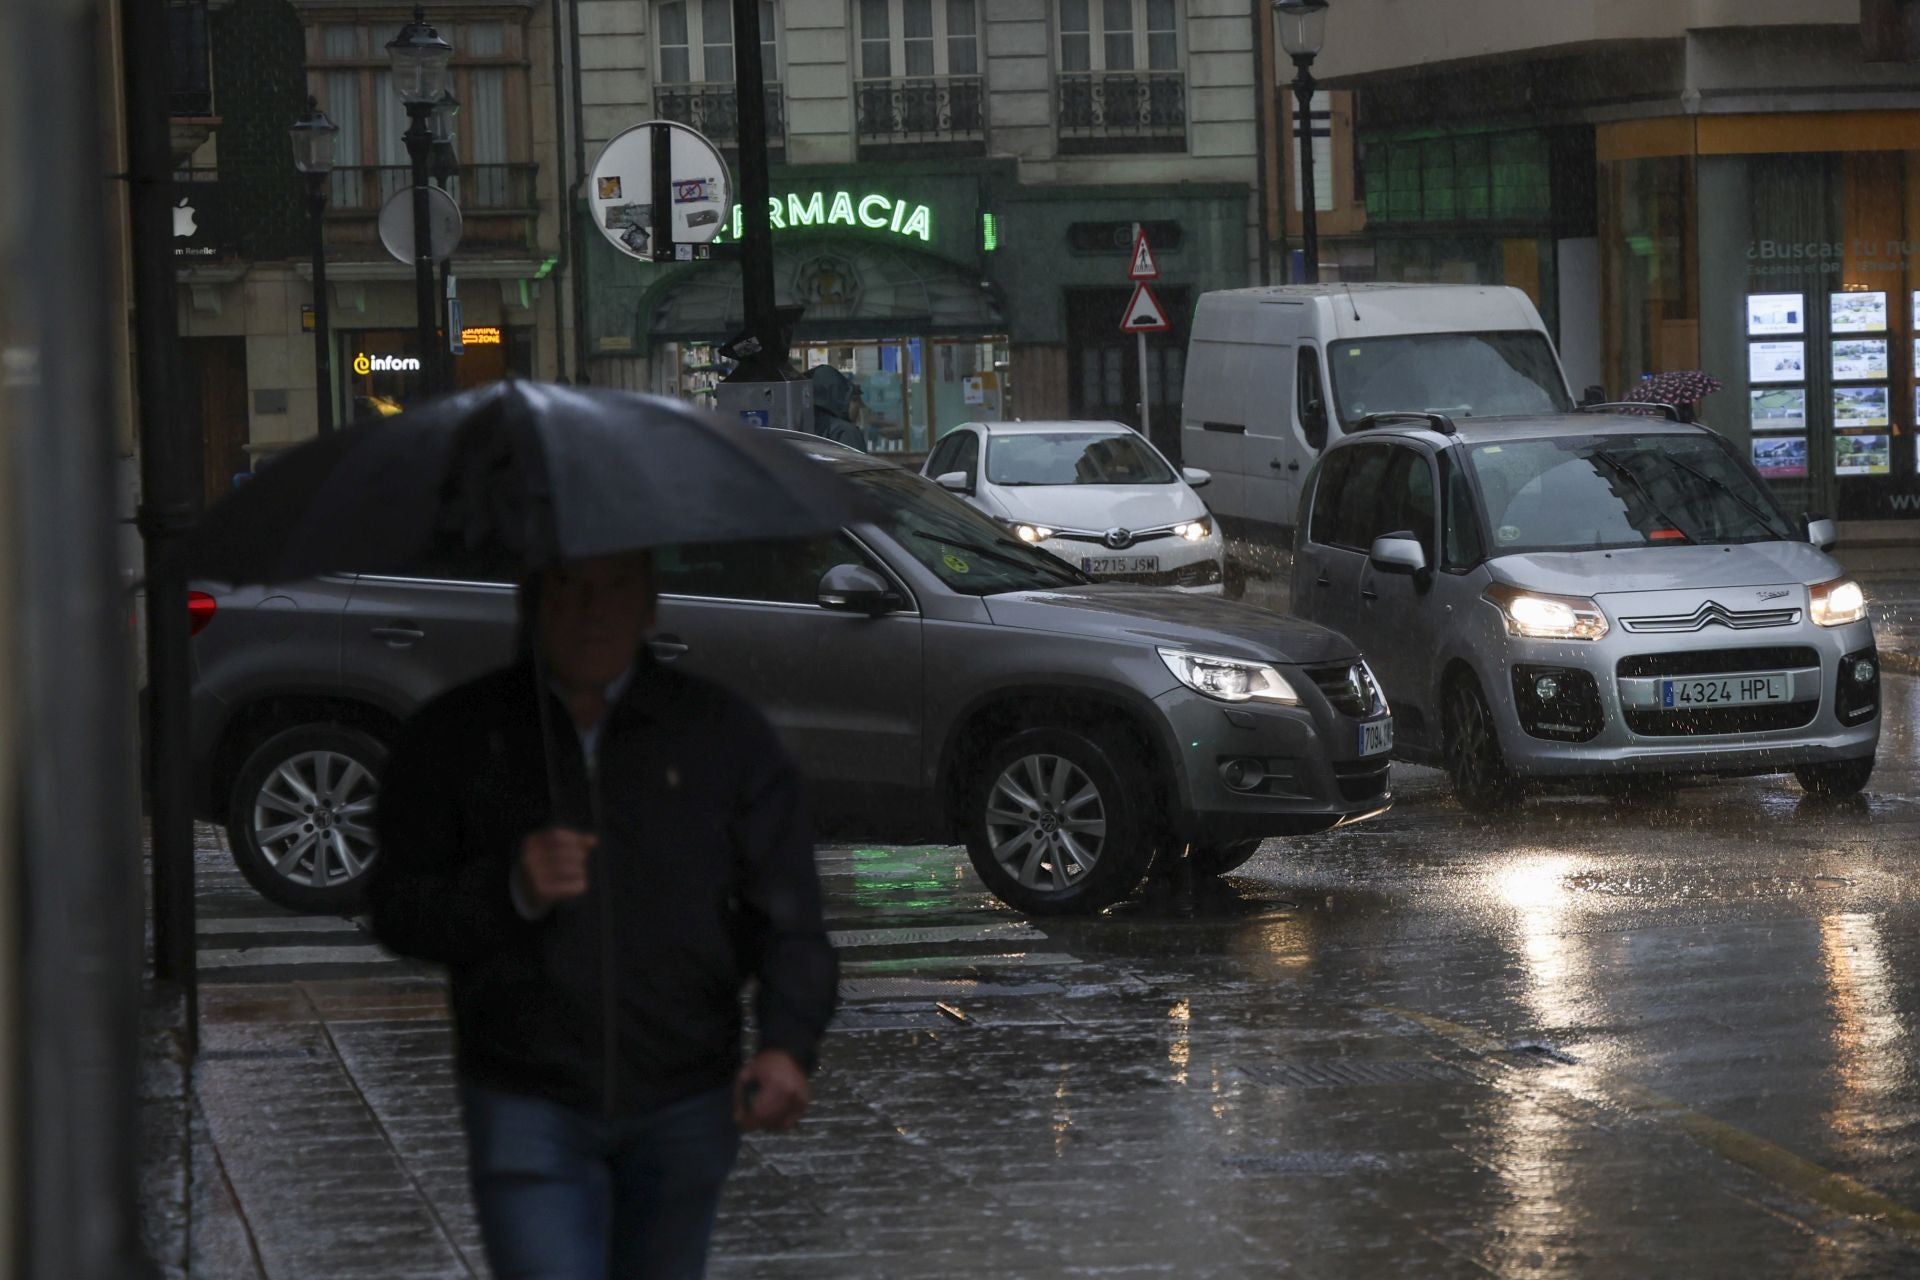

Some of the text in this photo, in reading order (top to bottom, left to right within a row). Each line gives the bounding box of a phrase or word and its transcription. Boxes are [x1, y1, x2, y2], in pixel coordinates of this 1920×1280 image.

[712, 191, 930, 242] RMACIA
[1747, 240, 1845, 259] ¿Buscas
[1853, 239, 1877, 257] tu
[478, 335, 500, 344] ZONE
[1093, 559, 1126, 572] 2715
[1680, 681, 1732, 703] 4324
[1741, 678, 1780, 701] HPL
